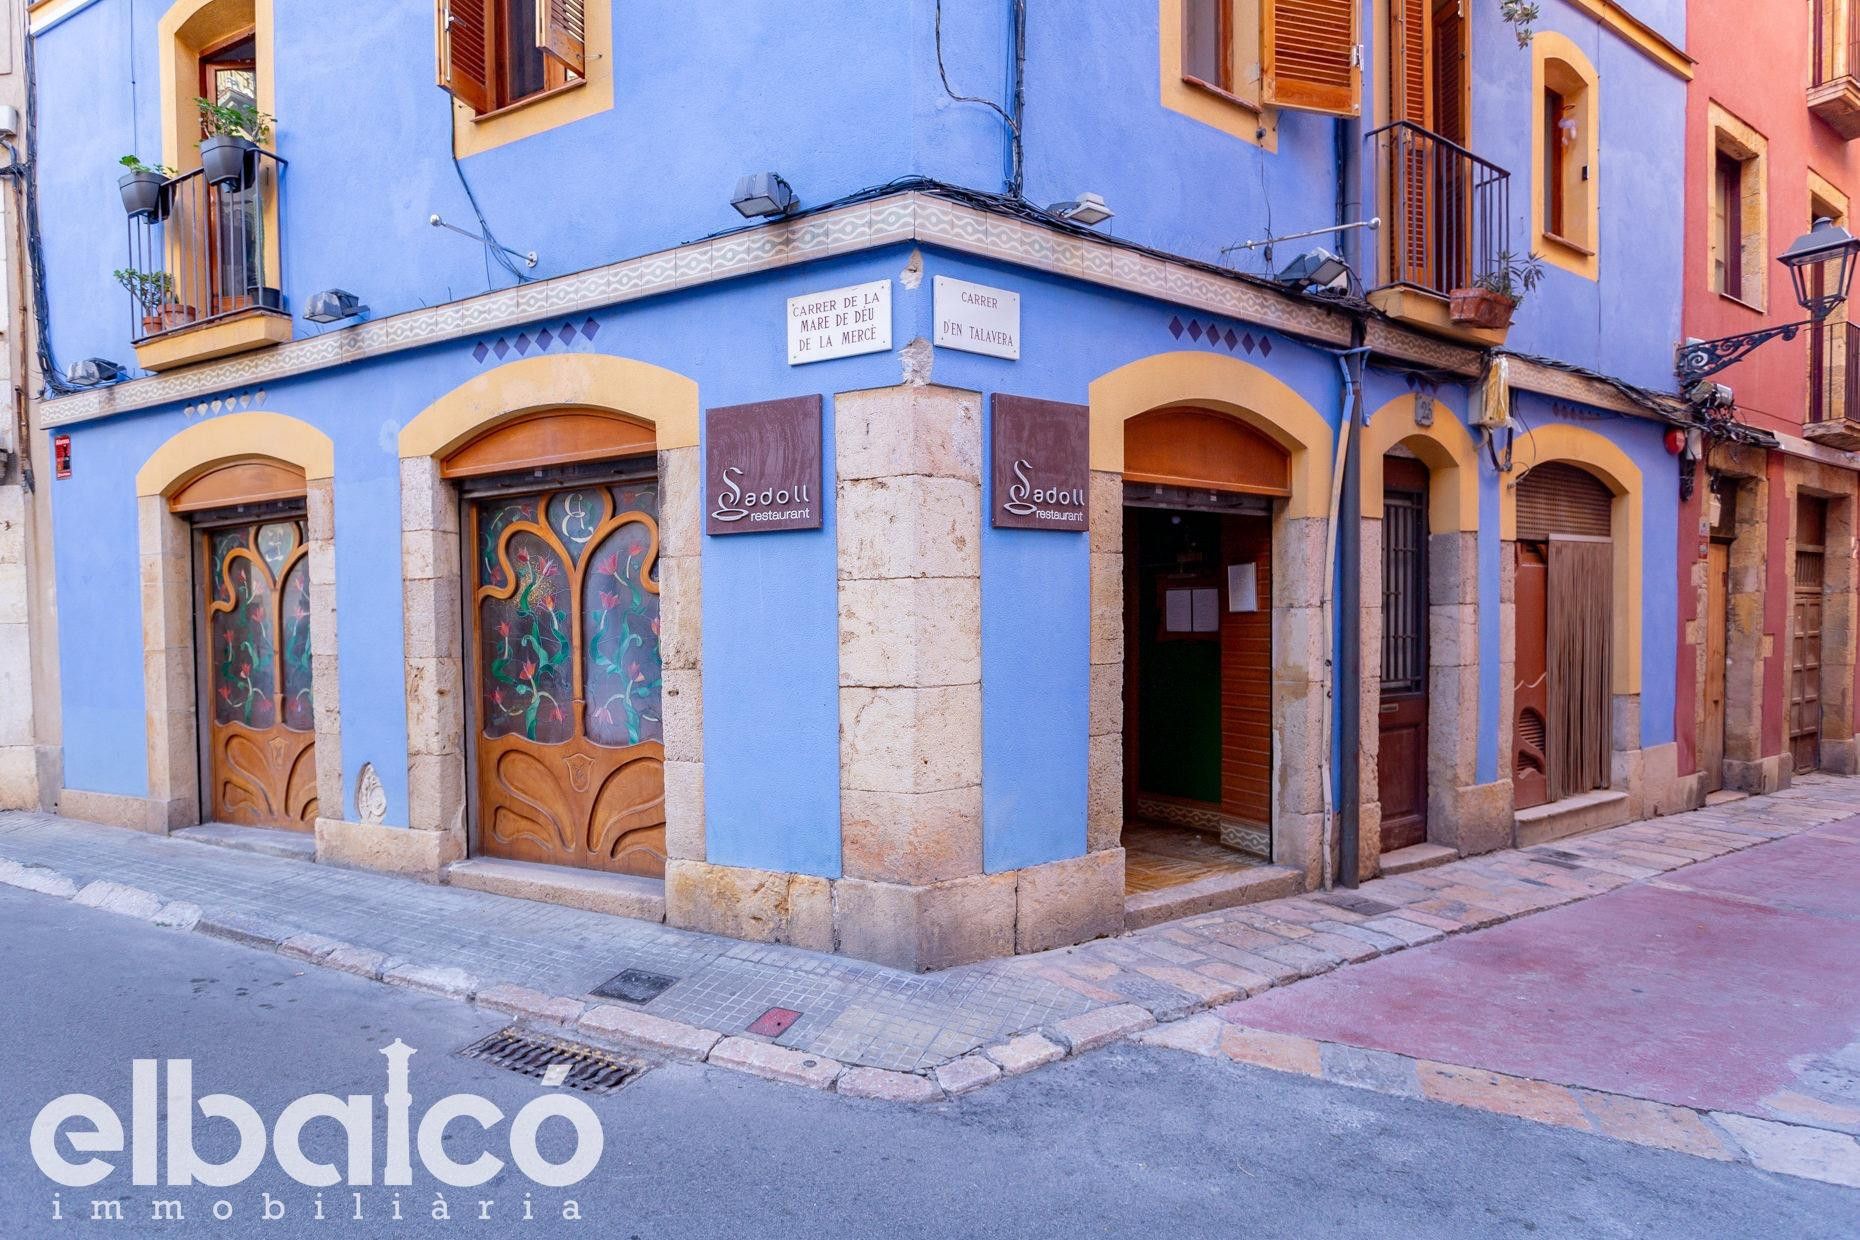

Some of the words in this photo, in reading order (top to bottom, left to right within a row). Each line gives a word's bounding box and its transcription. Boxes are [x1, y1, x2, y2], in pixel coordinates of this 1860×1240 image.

[793, 300, 837, 317] CARRER
[844, 296, 858, 308] DE
[864, 292, 880, 305] LA
[961, 291, 998, 309] CARRER
[800, 316, 830, 333] MARE
[836, 312, 849, 327] DE
[799, 338, 812, 352] DE
[819, 335, 833, 349] LA
[969, 326, 1014, 347] TALAVERA
[711, 466, 810, 522] Sadoll
[1003, 459, 1085, 515] Sadoll
[750, 507, 810, 522] restaurant
[1036, 509, 1084, 522] restaurant
